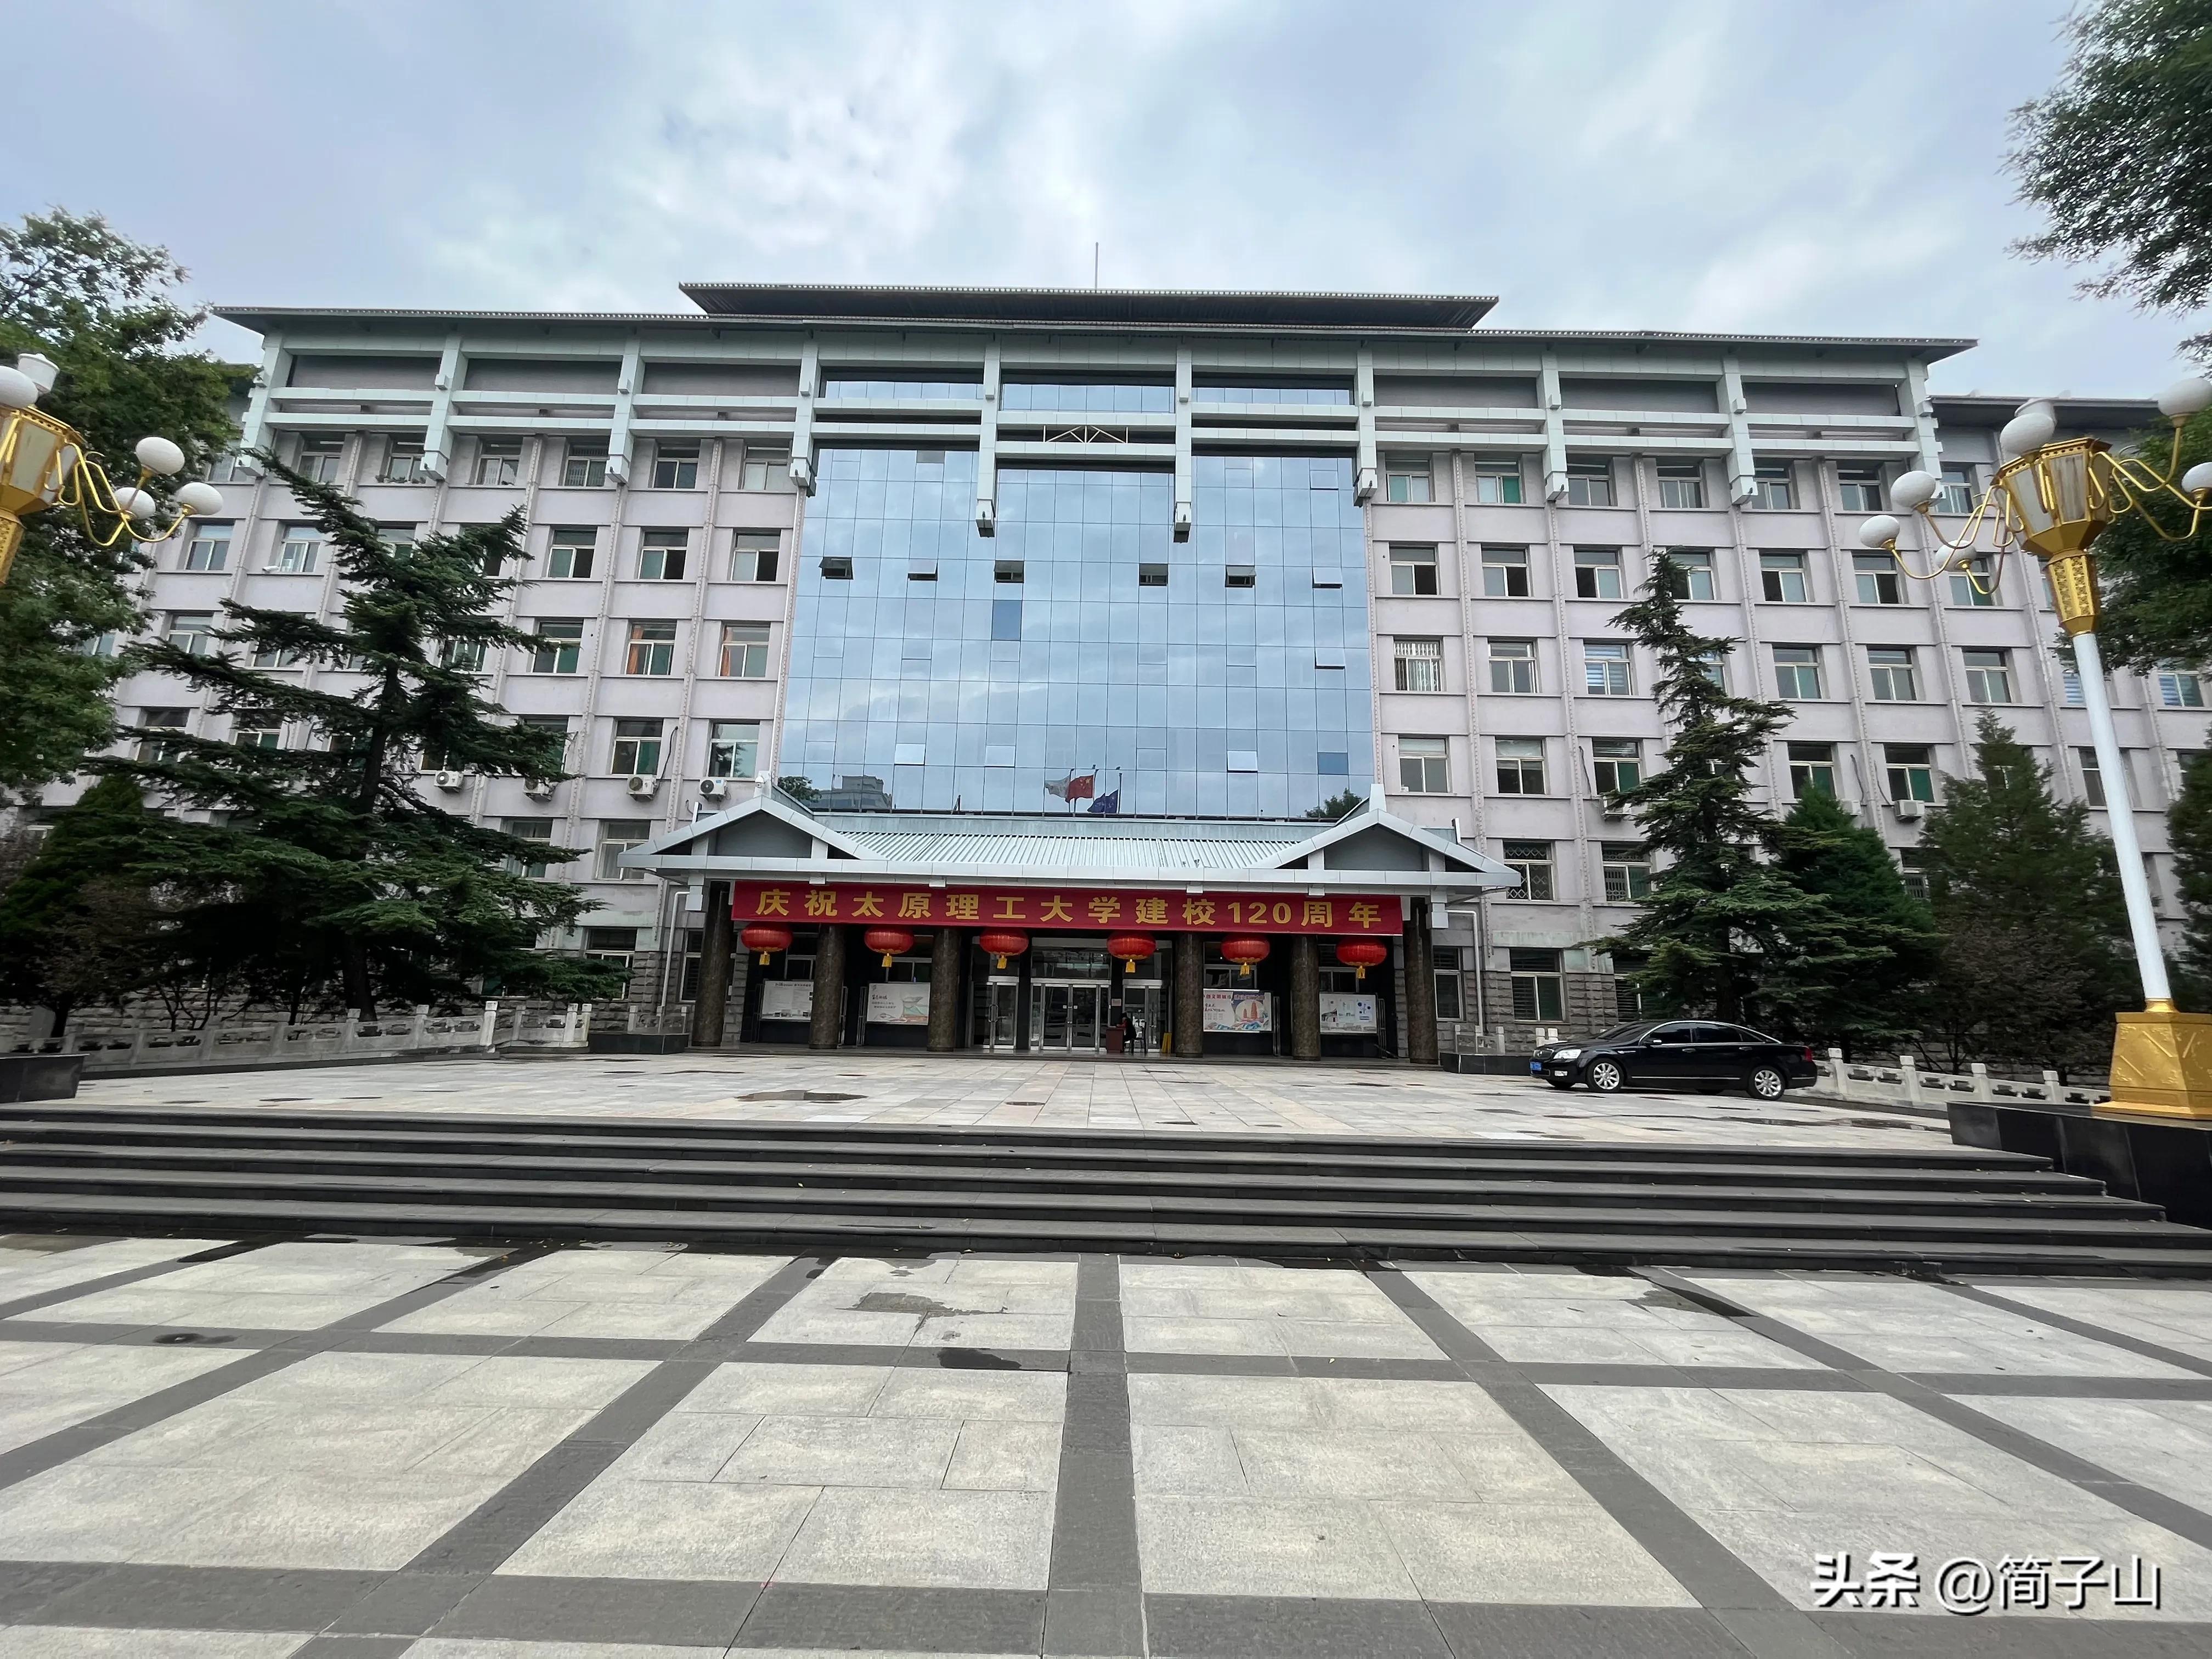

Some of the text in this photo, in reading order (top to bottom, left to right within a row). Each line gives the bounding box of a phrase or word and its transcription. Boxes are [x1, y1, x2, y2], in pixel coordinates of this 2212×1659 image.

[755, 889, 1382, 928] 庆祝太原理工大学建校120周年
